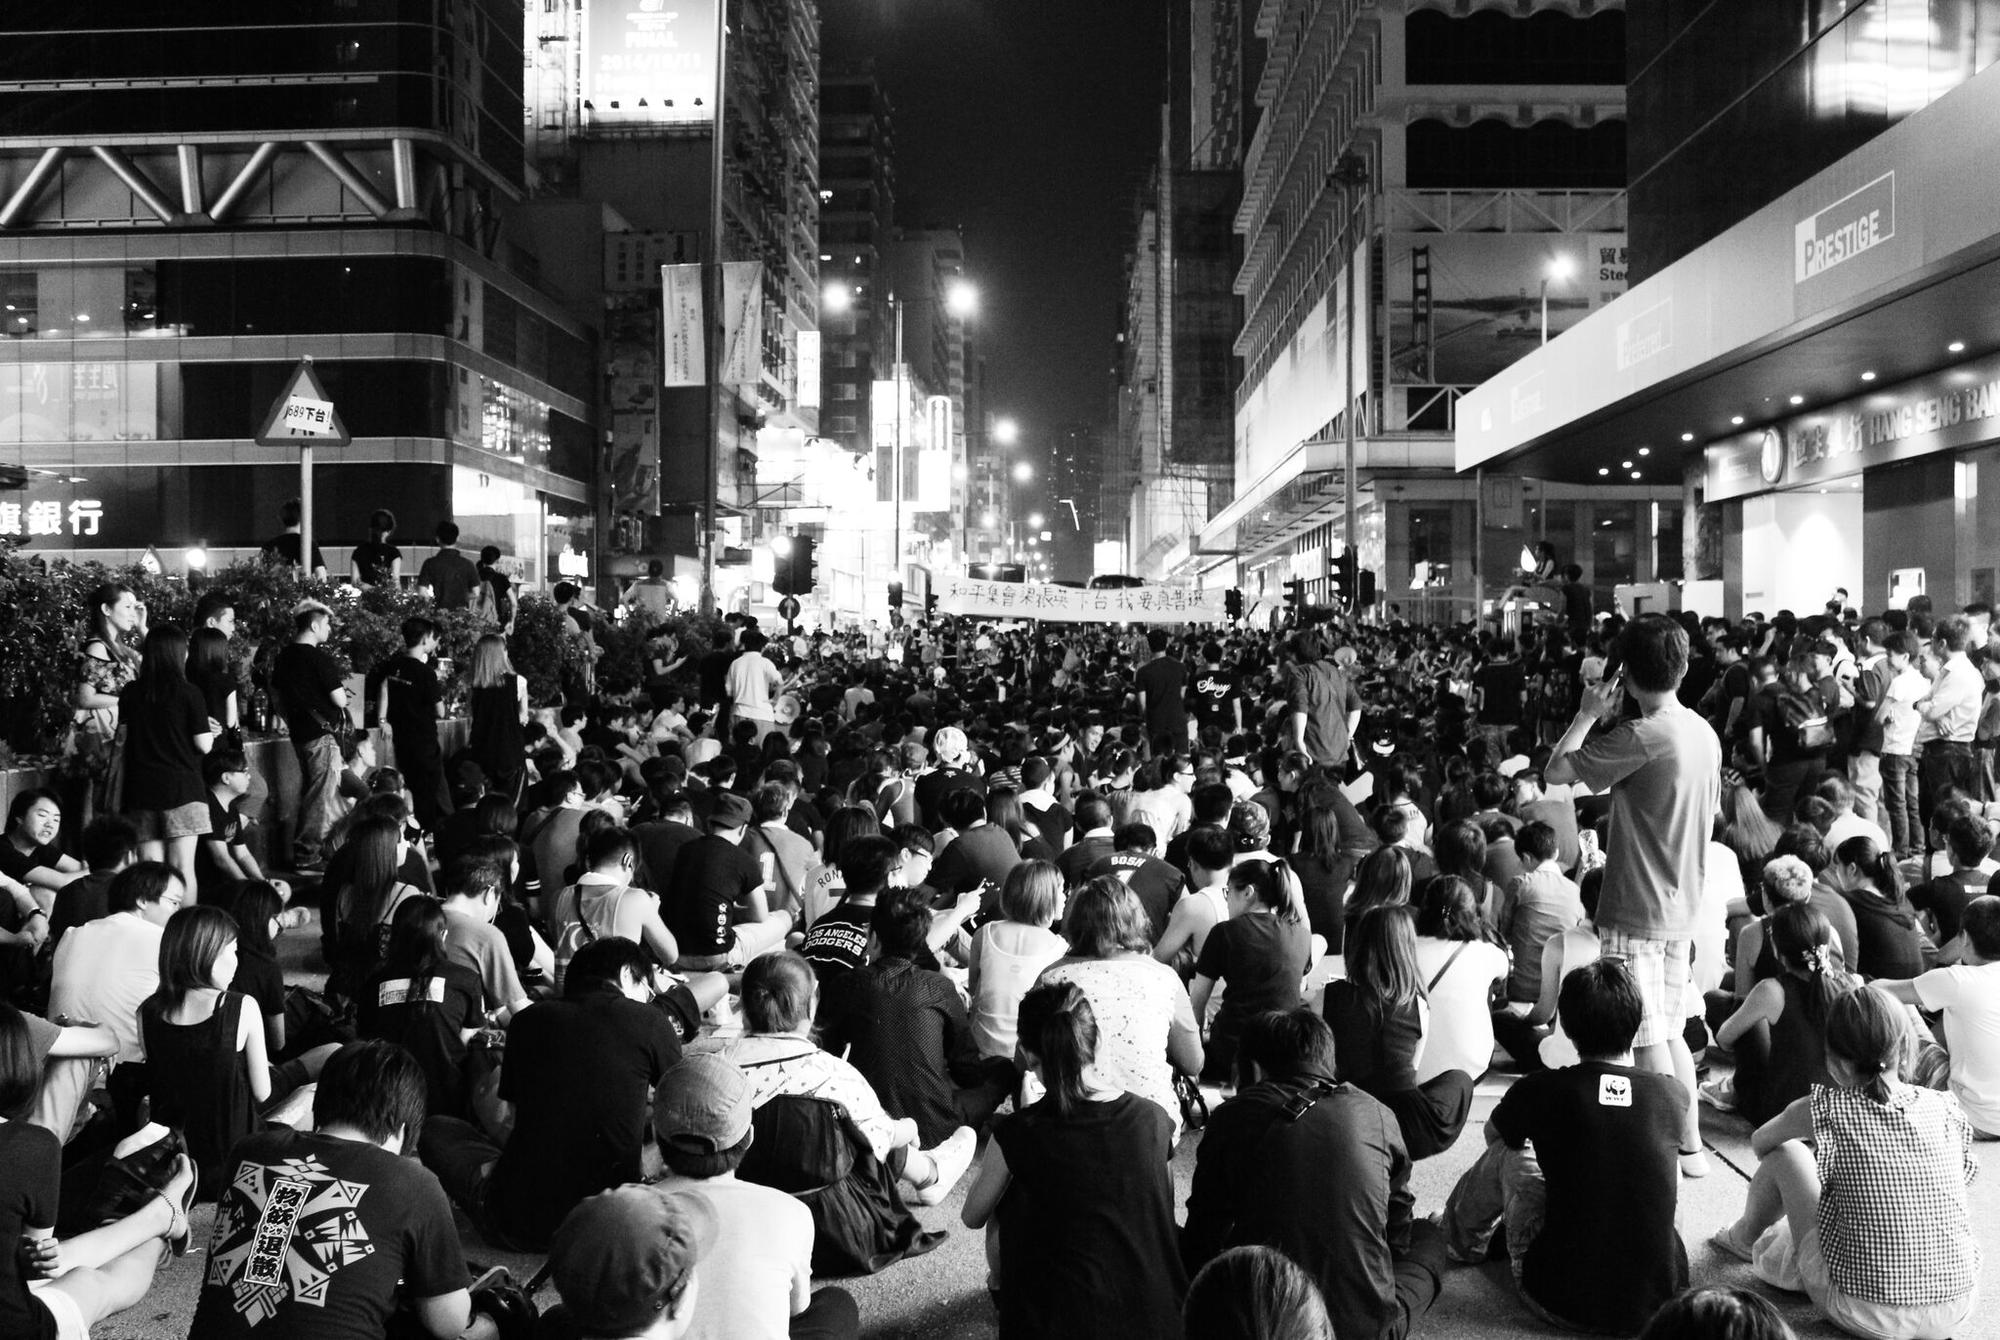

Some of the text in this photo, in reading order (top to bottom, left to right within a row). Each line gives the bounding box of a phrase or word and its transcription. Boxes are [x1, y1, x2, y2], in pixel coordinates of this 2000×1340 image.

[625, 31, 678, 48] FINAL
[1804, 209, 1880, 276] PRESTIGE
[1870, 406, 1912, 446] HANG
[1915, 393, 1961, 434] SENG
[1111, 856, 1146, 868] BOSH
[802, 937, 863, 957] DODGERS
[807, 928, 868, 948] LOS ANGELES
